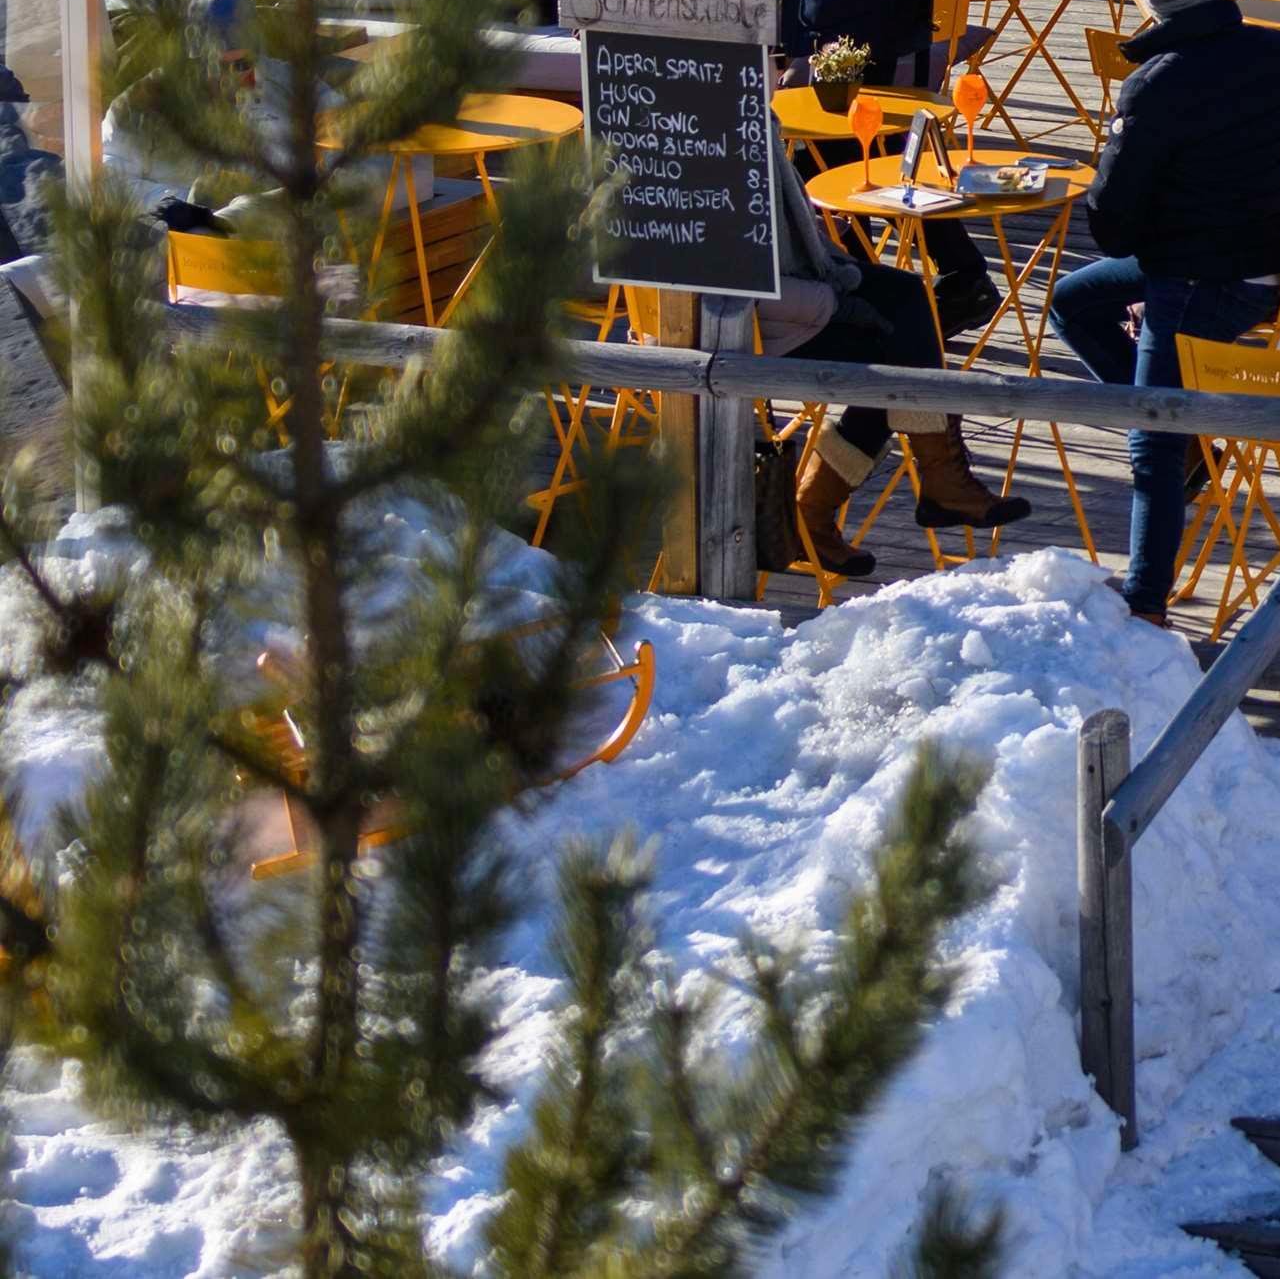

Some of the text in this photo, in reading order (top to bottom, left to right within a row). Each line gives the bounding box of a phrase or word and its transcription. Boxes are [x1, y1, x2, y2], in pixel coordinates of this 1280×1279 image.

[596, 44, 663, 77] APEROL
[665, 58, 724, 84] SPRITZ
[600, 81, 656, 106] HUGO
[596, 103, 631, 127] GIN
[650, 111, 699, 135] TONIC
[600, 129, 660, 151] VODKA
[605, 219, 706, 244] WILLIAMINE
